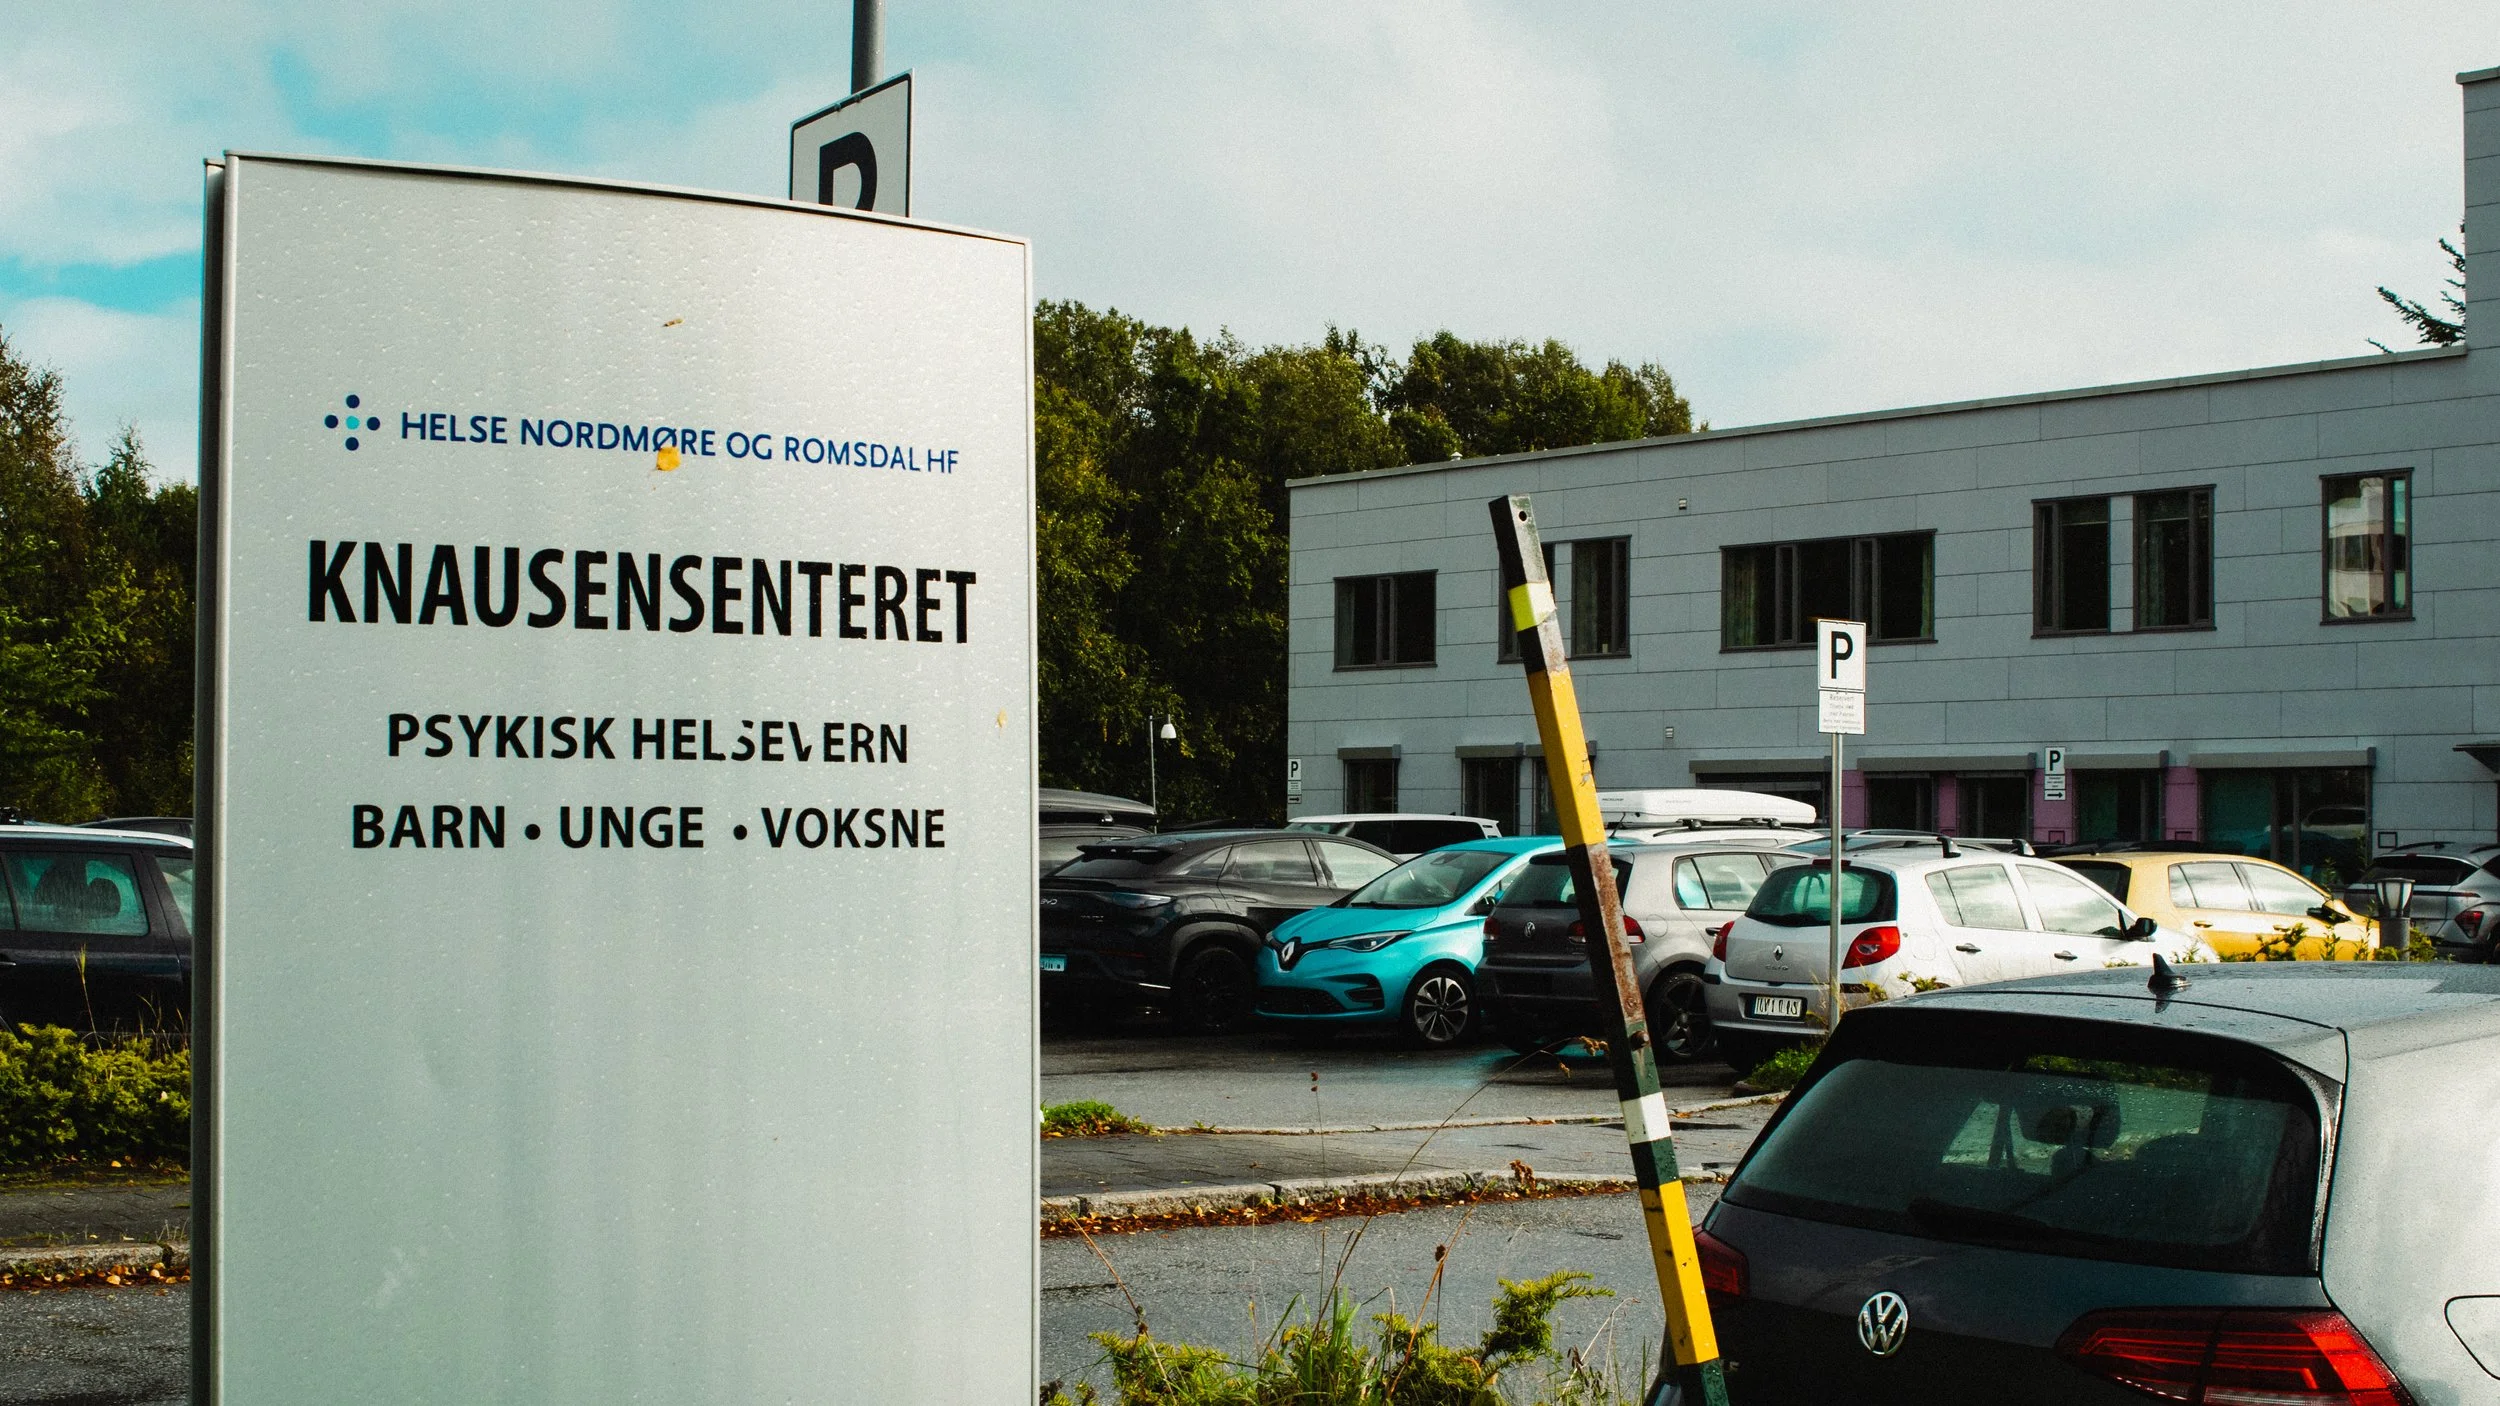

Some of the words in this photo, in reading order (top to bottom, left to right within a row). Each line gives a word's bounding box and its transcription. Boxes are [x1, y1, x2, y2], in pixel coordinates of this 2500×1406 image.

[818, 131, 878, 212] P
[401, 411, 508, 445] HELSE
[520, 418, 717, 457] NORDMØRE
[725, 431, 773, 461] OG
[784, 436, 921, 472] ROMSDAL
[927, 449, 959, 474] HF
[308, 539, 978, 645] KNAUSENSENTERET
[1831, 630, 1854, 680] P
[388, 712, 616, 760] PSYKISK
[2050, 750, 2061, 771] P
[1291, 761, 1299, 778] P
[352, 804, 505, 849] BARN
[559, 805, 704, 849] UNGE
[760, 807, 945, 849] VOKSNE
